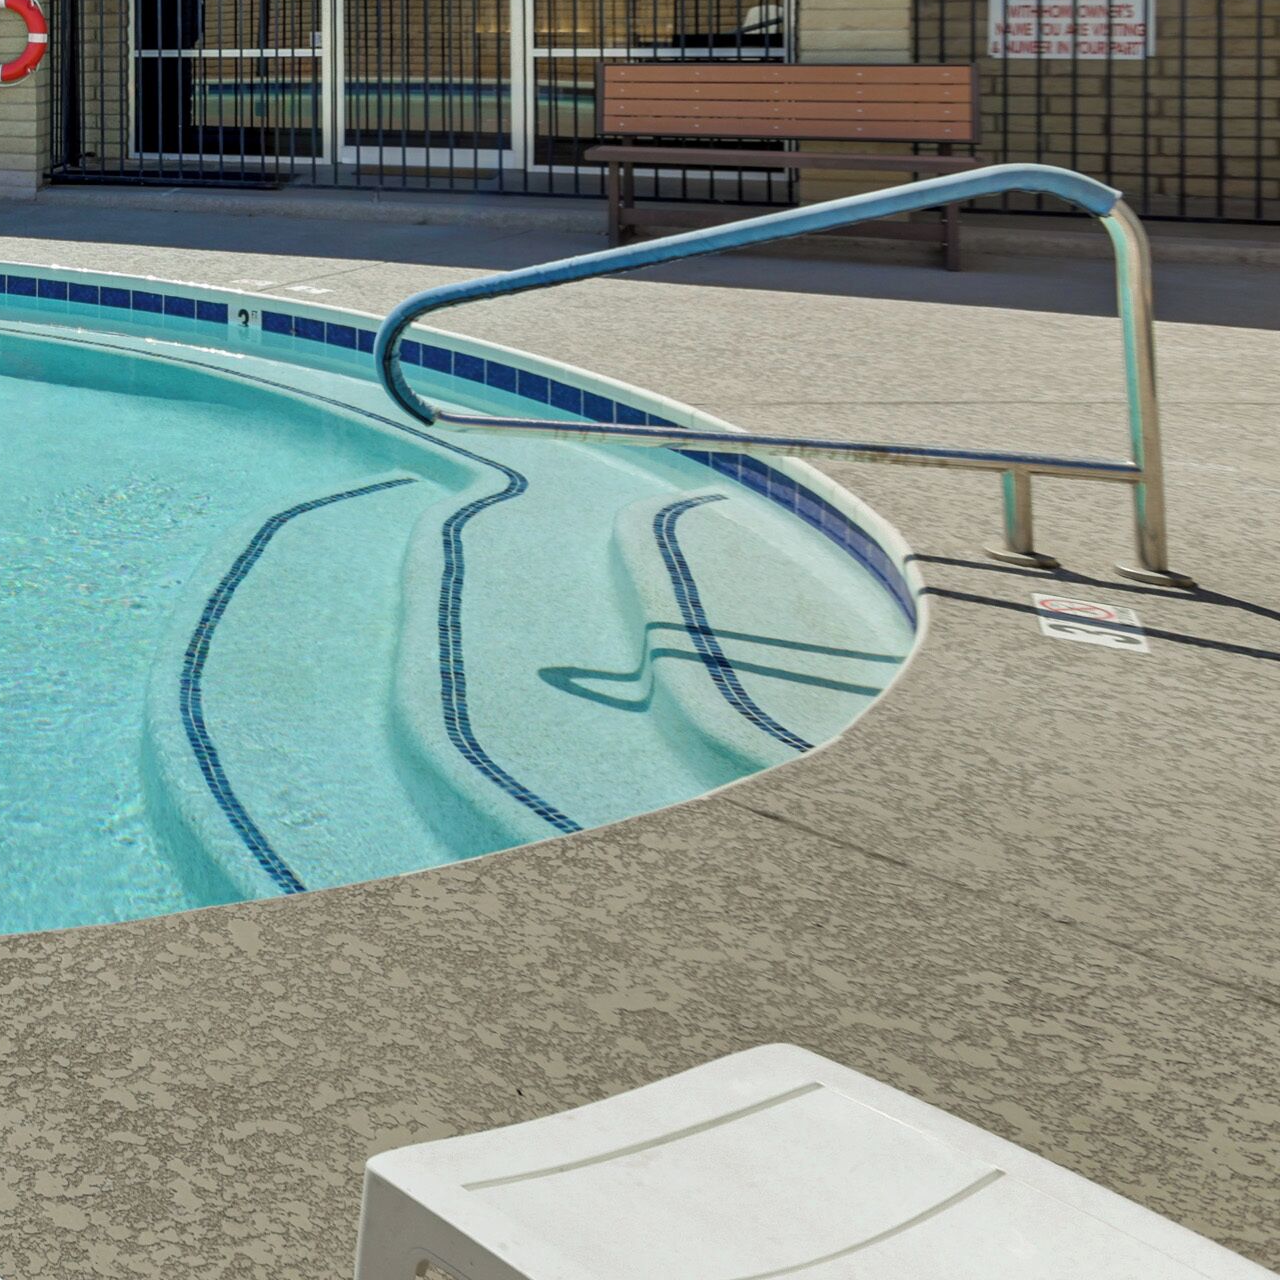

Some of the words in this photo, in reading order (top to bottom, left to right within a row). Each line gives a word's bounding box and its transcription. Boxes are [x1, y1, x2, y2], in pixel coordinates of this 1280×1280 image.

[1042, 5, 1078, 18] HOM
[1037, 23, 1061, 36] OU
[1073, 41, 1107, 54] OUR
